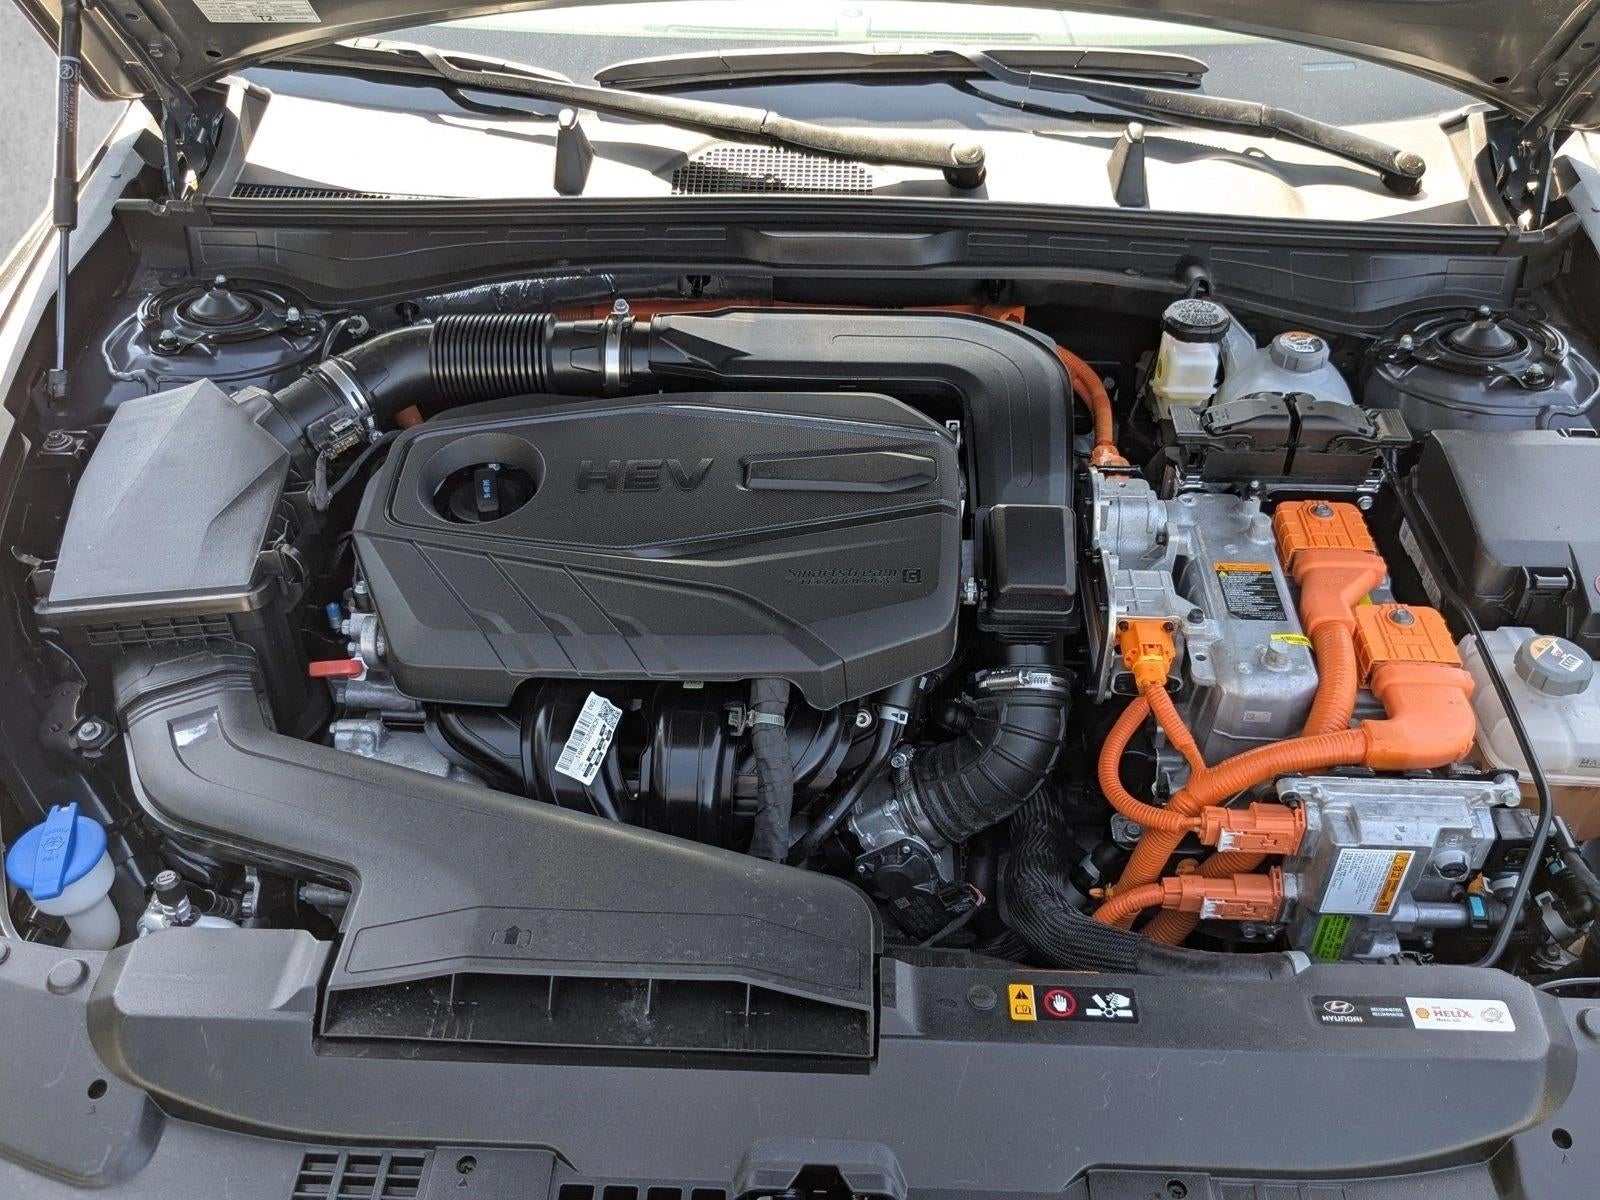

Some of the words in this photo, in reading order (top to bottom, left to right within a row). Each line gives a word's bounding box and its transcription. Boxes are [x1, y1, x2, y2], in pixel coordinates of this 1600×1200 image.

[576, 457, 714, 493] HEV
[787, 566, 898, 579] Smartstream
[1322, 1015, 1363, 1023] HYUNDAI
[1433, 1010, 1471, 1018] HELIX
